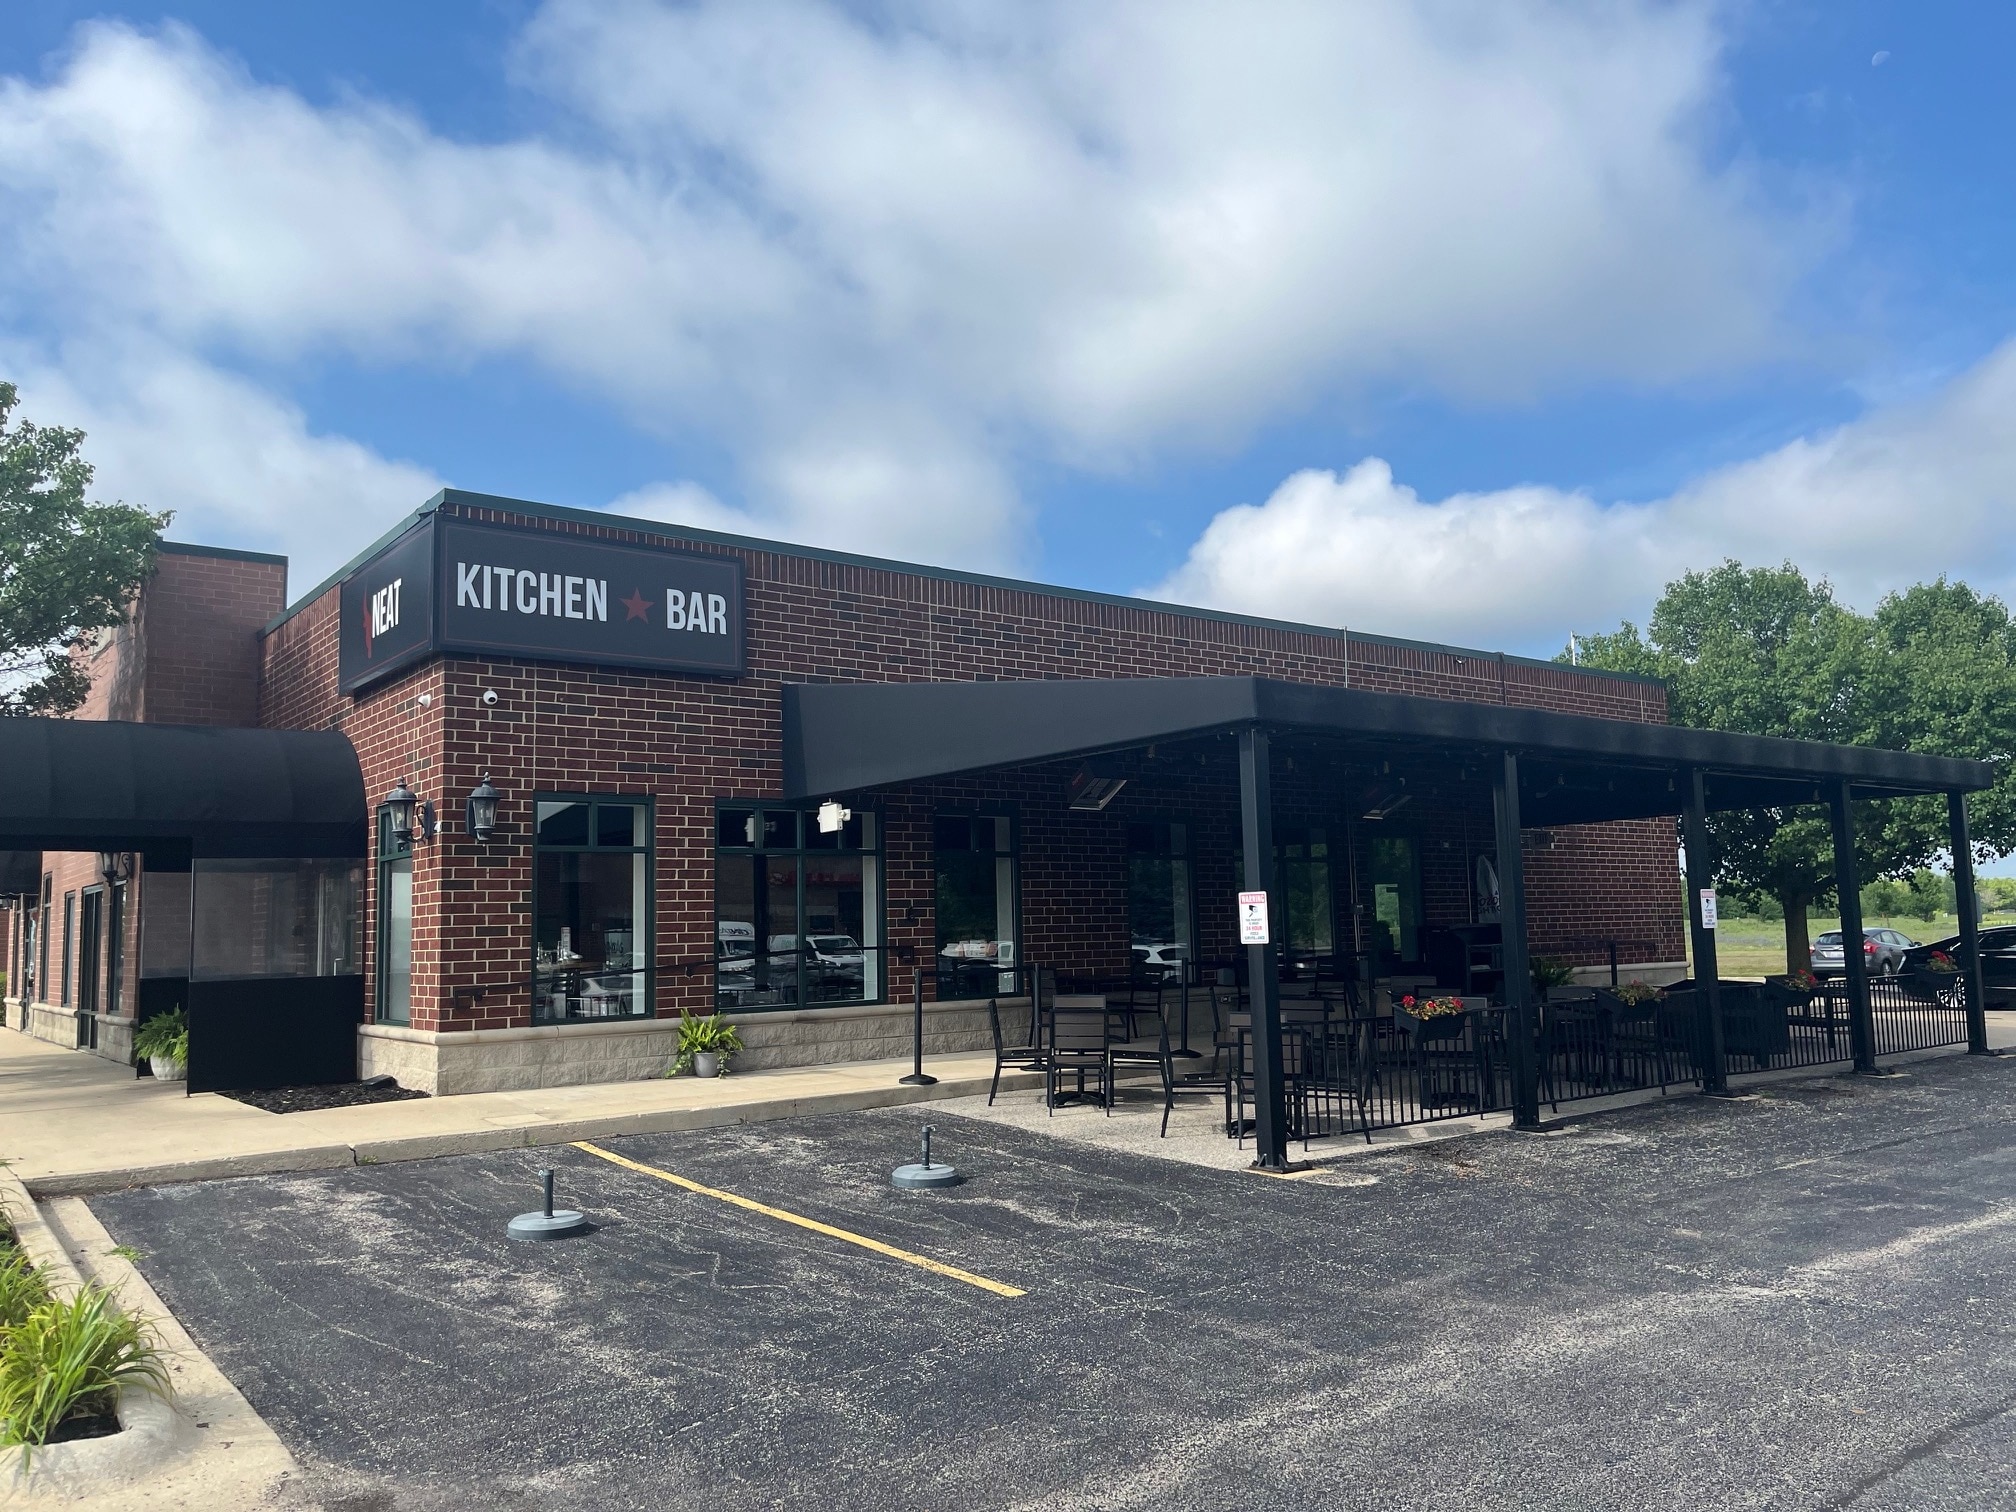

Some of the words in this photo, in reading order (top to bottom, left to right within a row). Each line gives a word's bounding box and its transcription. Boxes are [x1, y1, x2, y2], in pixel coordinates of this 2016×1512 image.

[371, 578, 402, 639] NEAT
[456, 562, 608, 622] KITCHEN
[666, 588, 728, 635] BAR
[1241, 894, 1265, 903] WARNING
